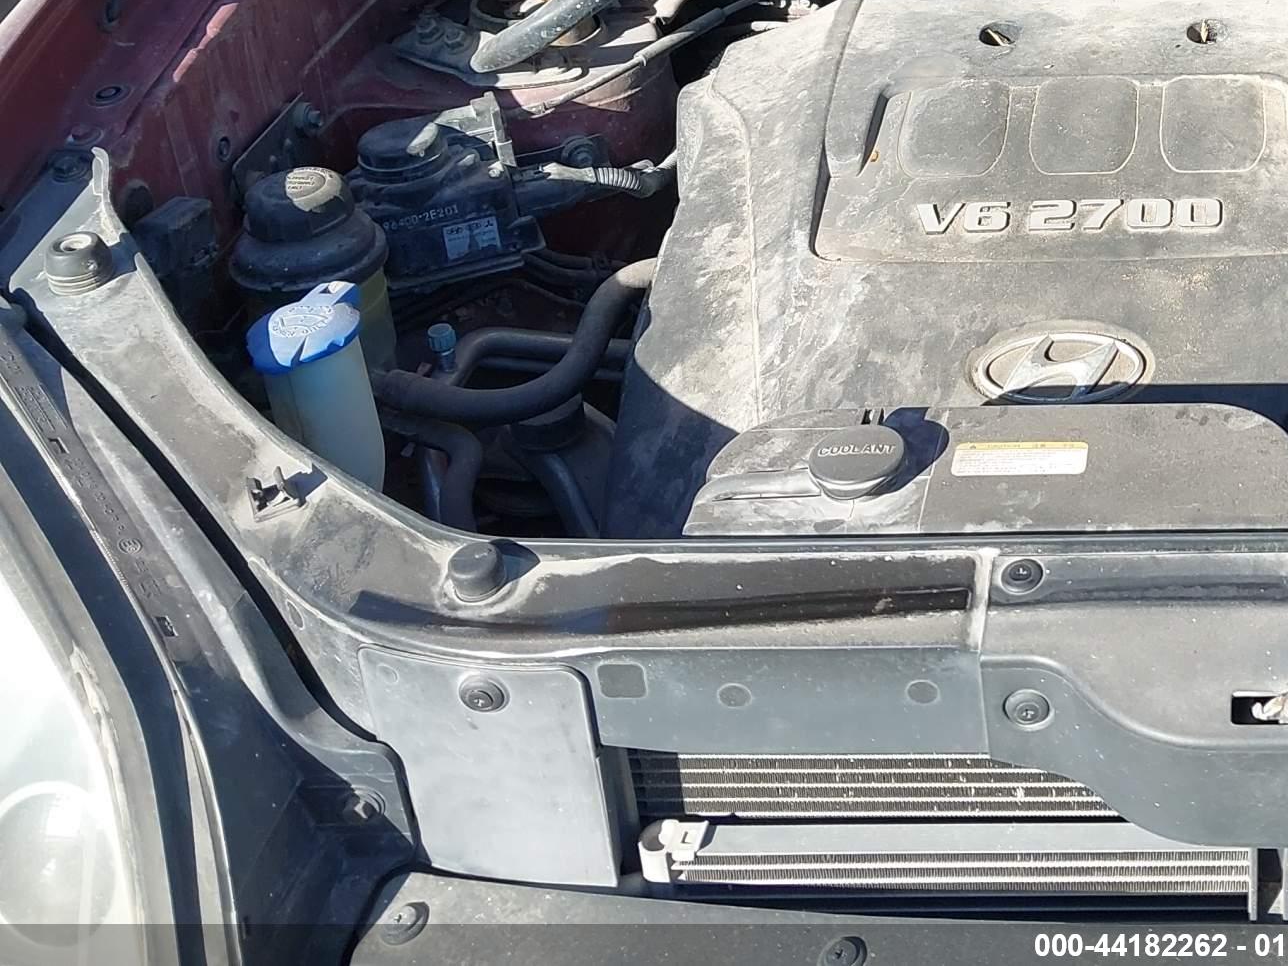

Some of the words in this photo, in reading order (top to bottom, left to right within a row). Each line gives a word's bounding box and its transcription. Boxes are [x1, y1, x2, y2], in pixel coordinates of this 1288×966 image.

[916, 201, 1012, 235] V6
[1028, 198, 1224, 232] 2700
[818, 443, 896, 457] COOLANT
